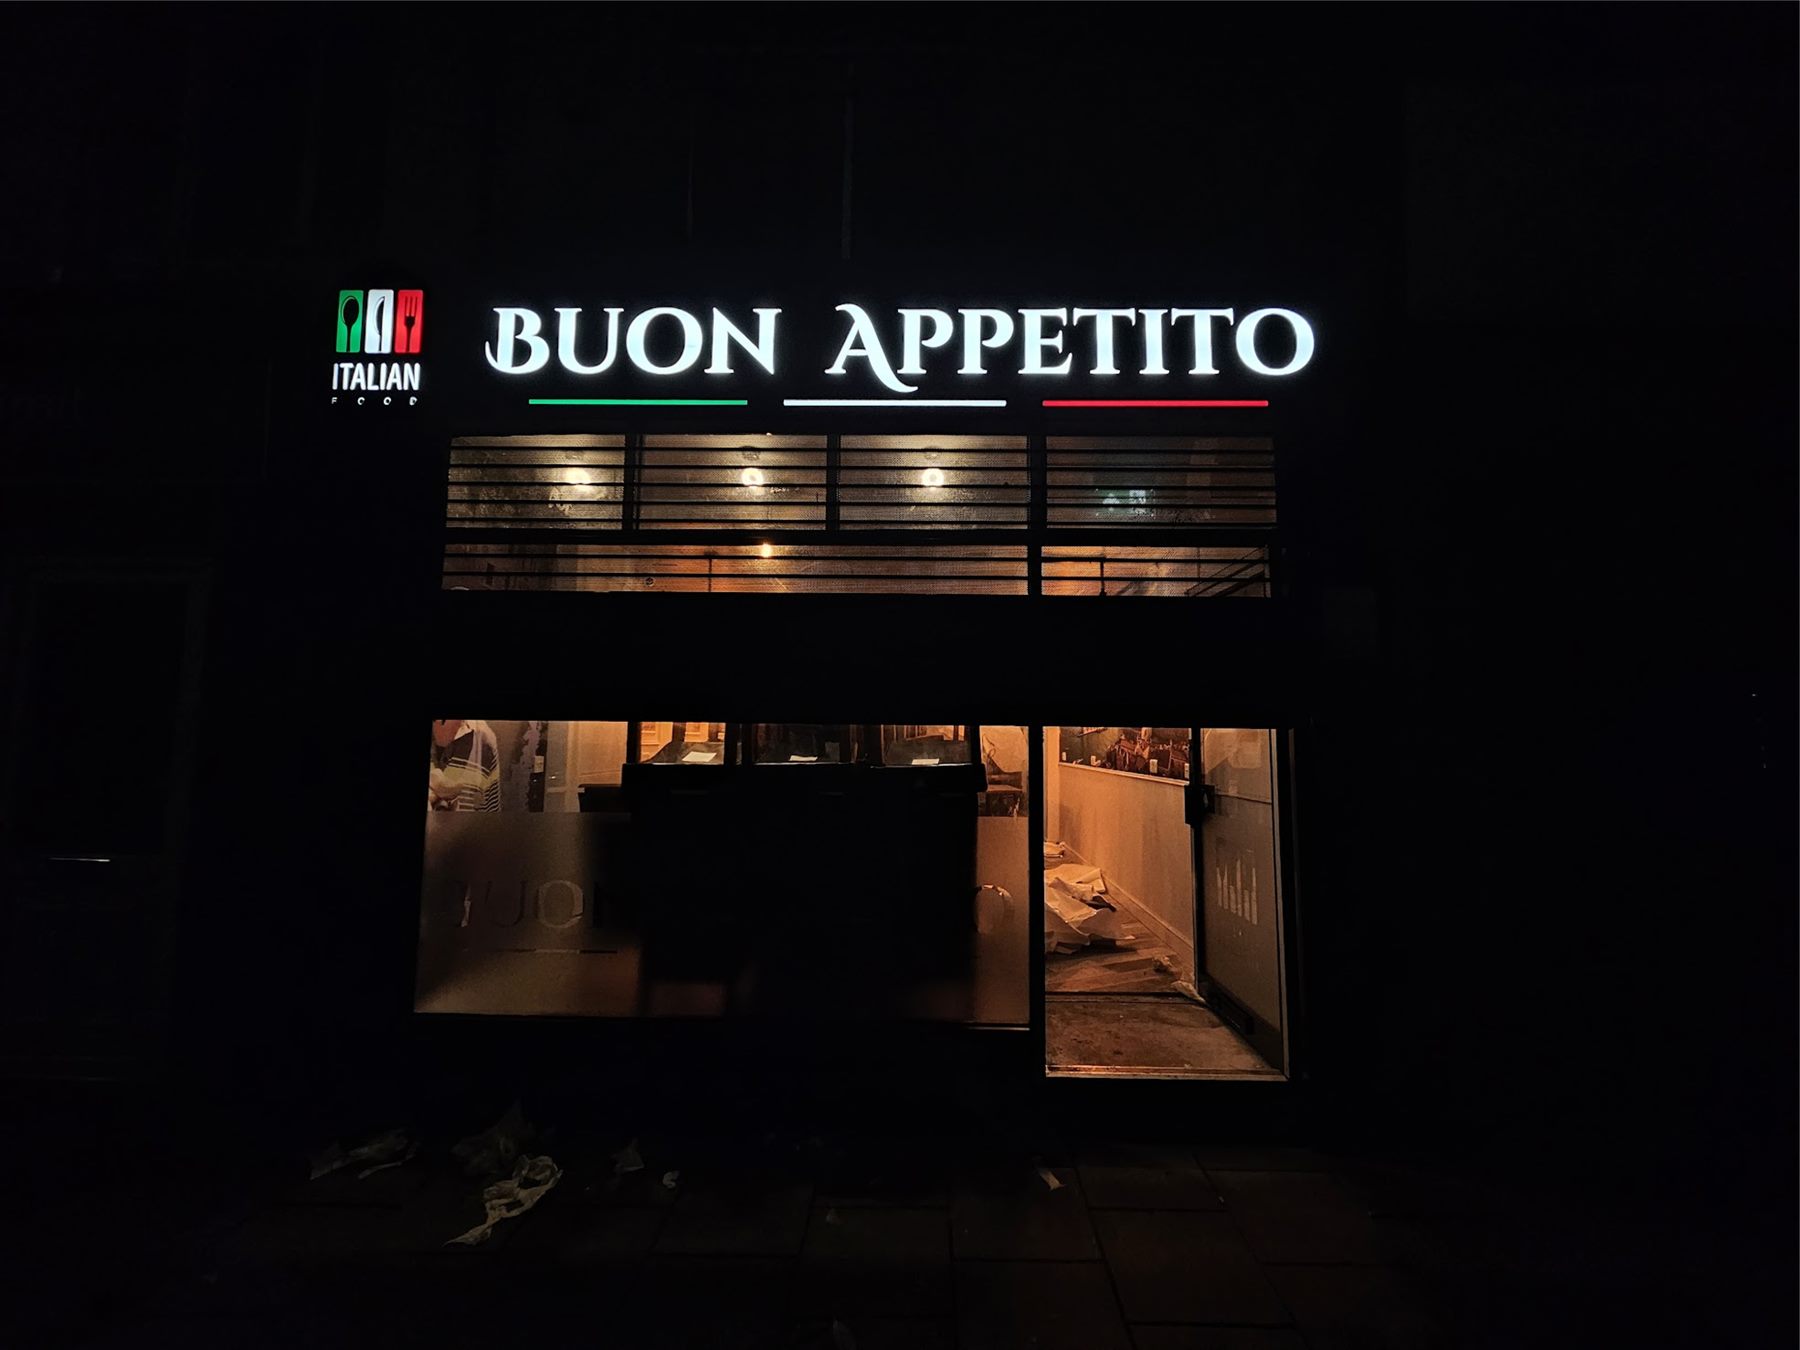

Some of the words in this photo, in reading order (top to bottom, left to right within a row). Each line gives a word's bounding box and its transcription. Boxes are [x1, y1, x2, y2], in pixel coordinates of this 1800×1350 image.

[332, 362, 421, 391] ITALIAN
[485, 306, 782, 375] BUON
[824, 303, 1315, 393] APPETITO
